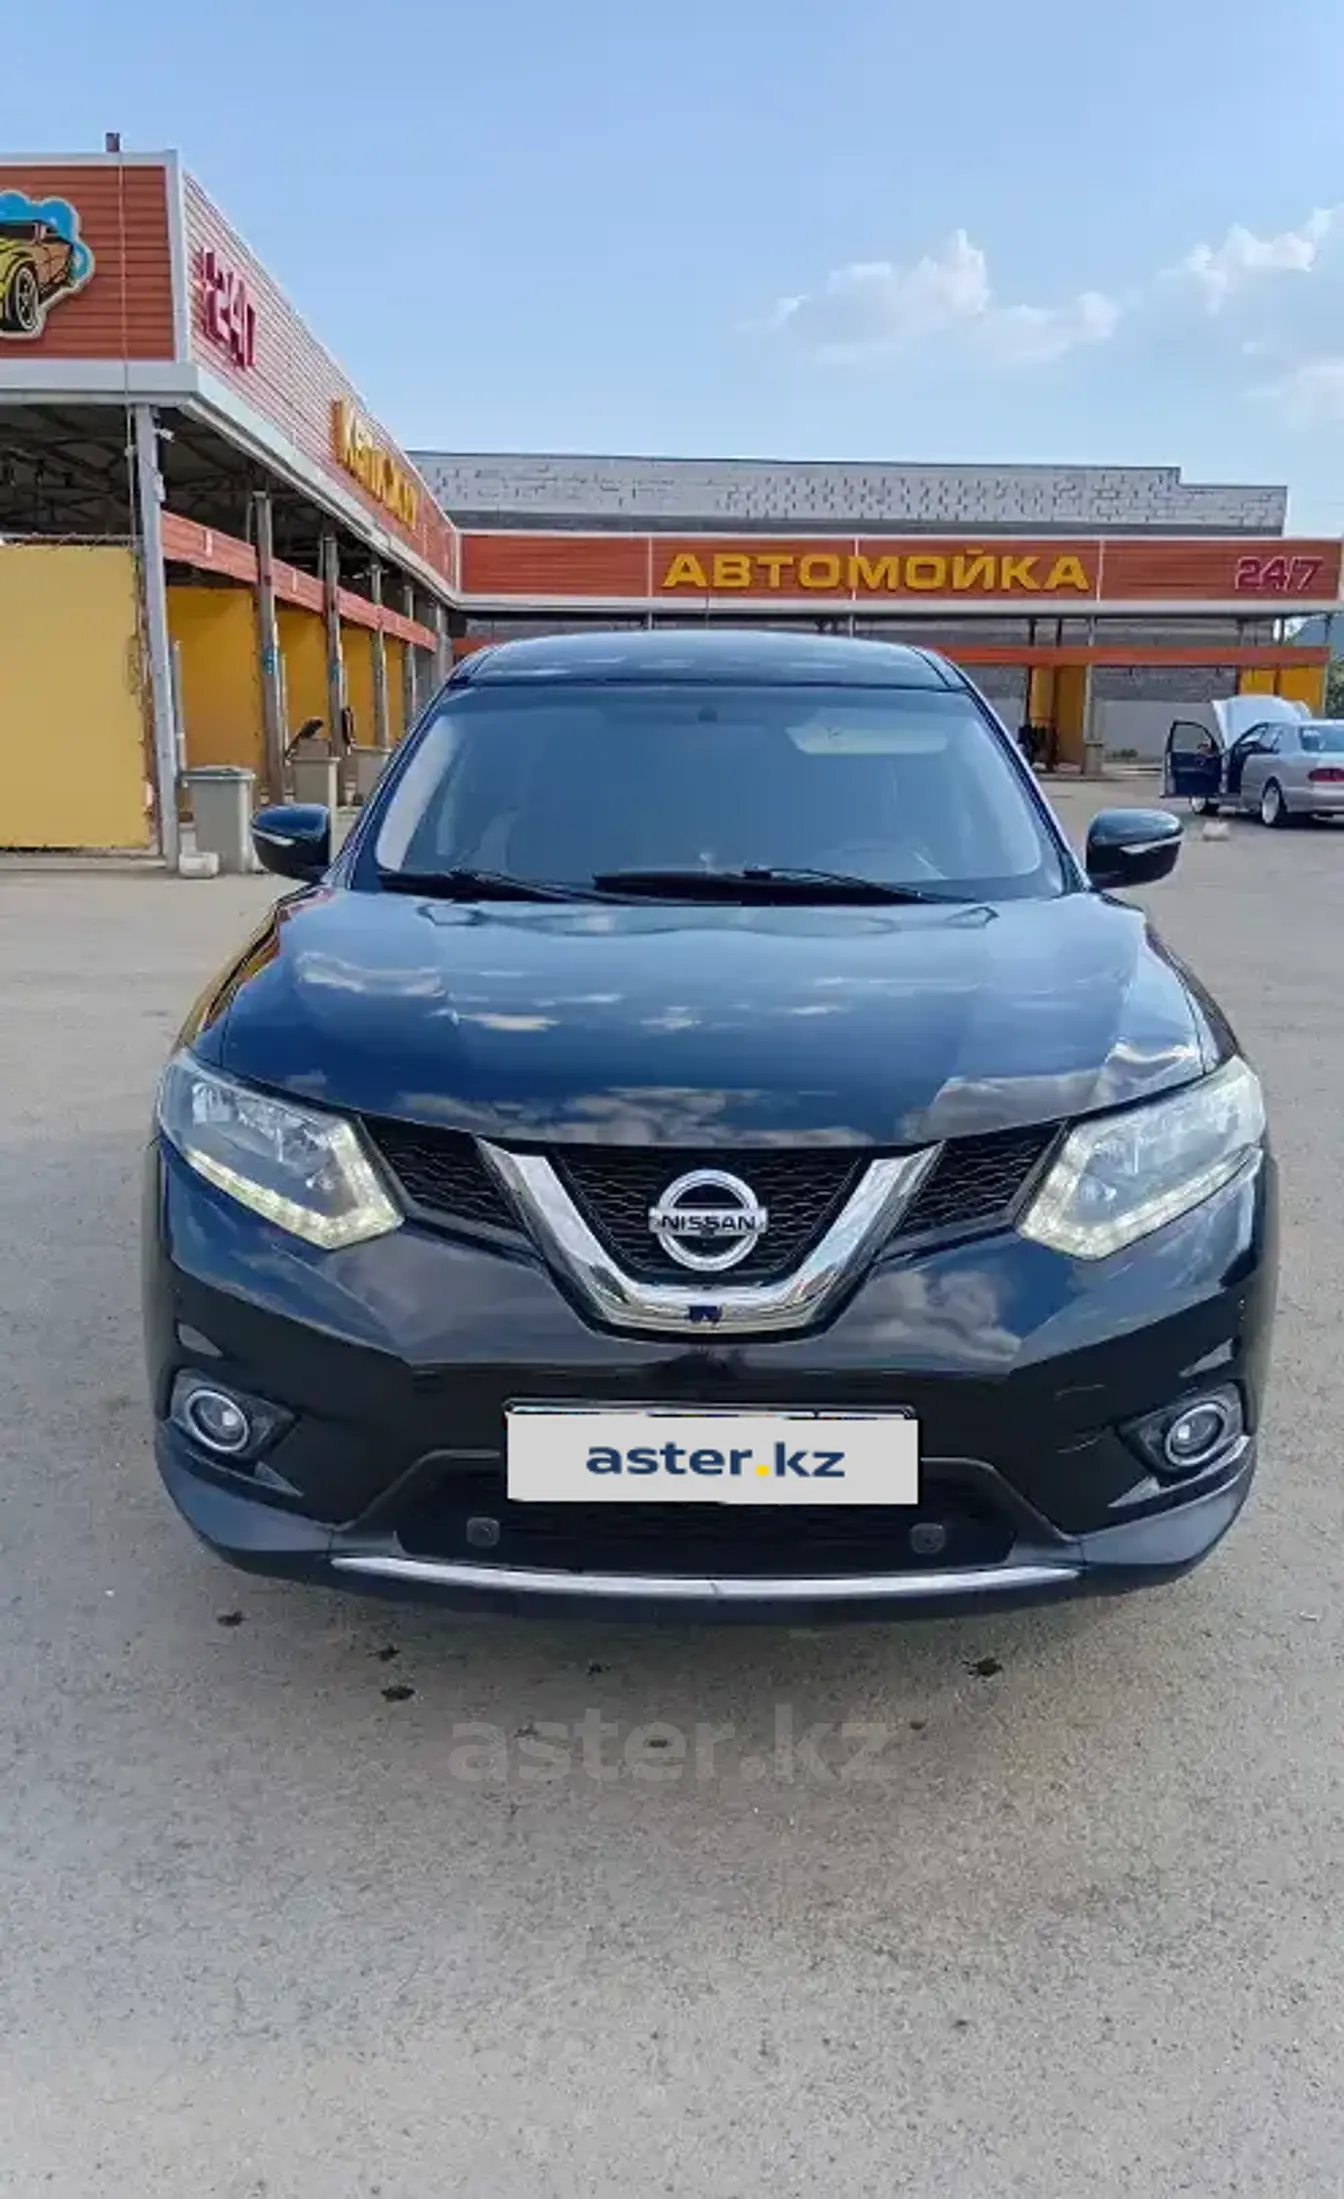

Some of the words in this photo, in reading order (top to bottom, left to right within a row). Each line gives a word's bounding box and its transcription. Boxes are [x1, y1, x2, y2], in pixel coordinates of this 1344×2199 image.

[661, 548, 1090, 591] АВТОМОЙКА
[1234, 555, 1324, 592] 24/7
[660, 1214, 757, 1231] NISSAN
